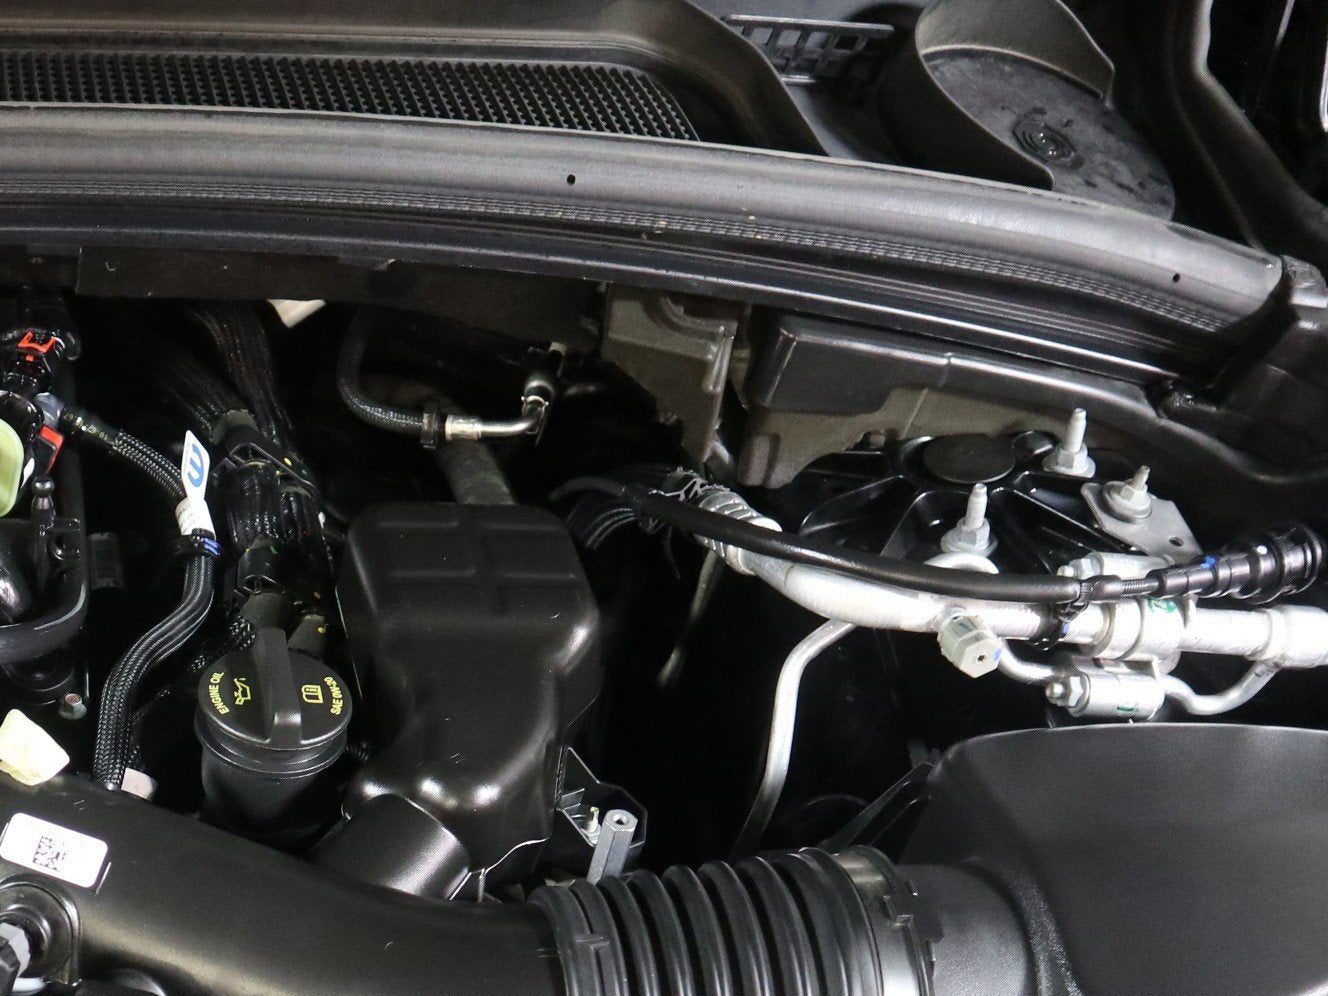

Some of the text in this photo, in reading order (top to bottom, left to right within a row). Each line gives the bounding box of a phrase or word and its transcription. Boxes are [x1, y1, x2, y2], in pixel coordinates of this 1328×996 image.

[208, 672, 230, 714] ENGINE OIL
[330, 698, 343, 715] SAE
